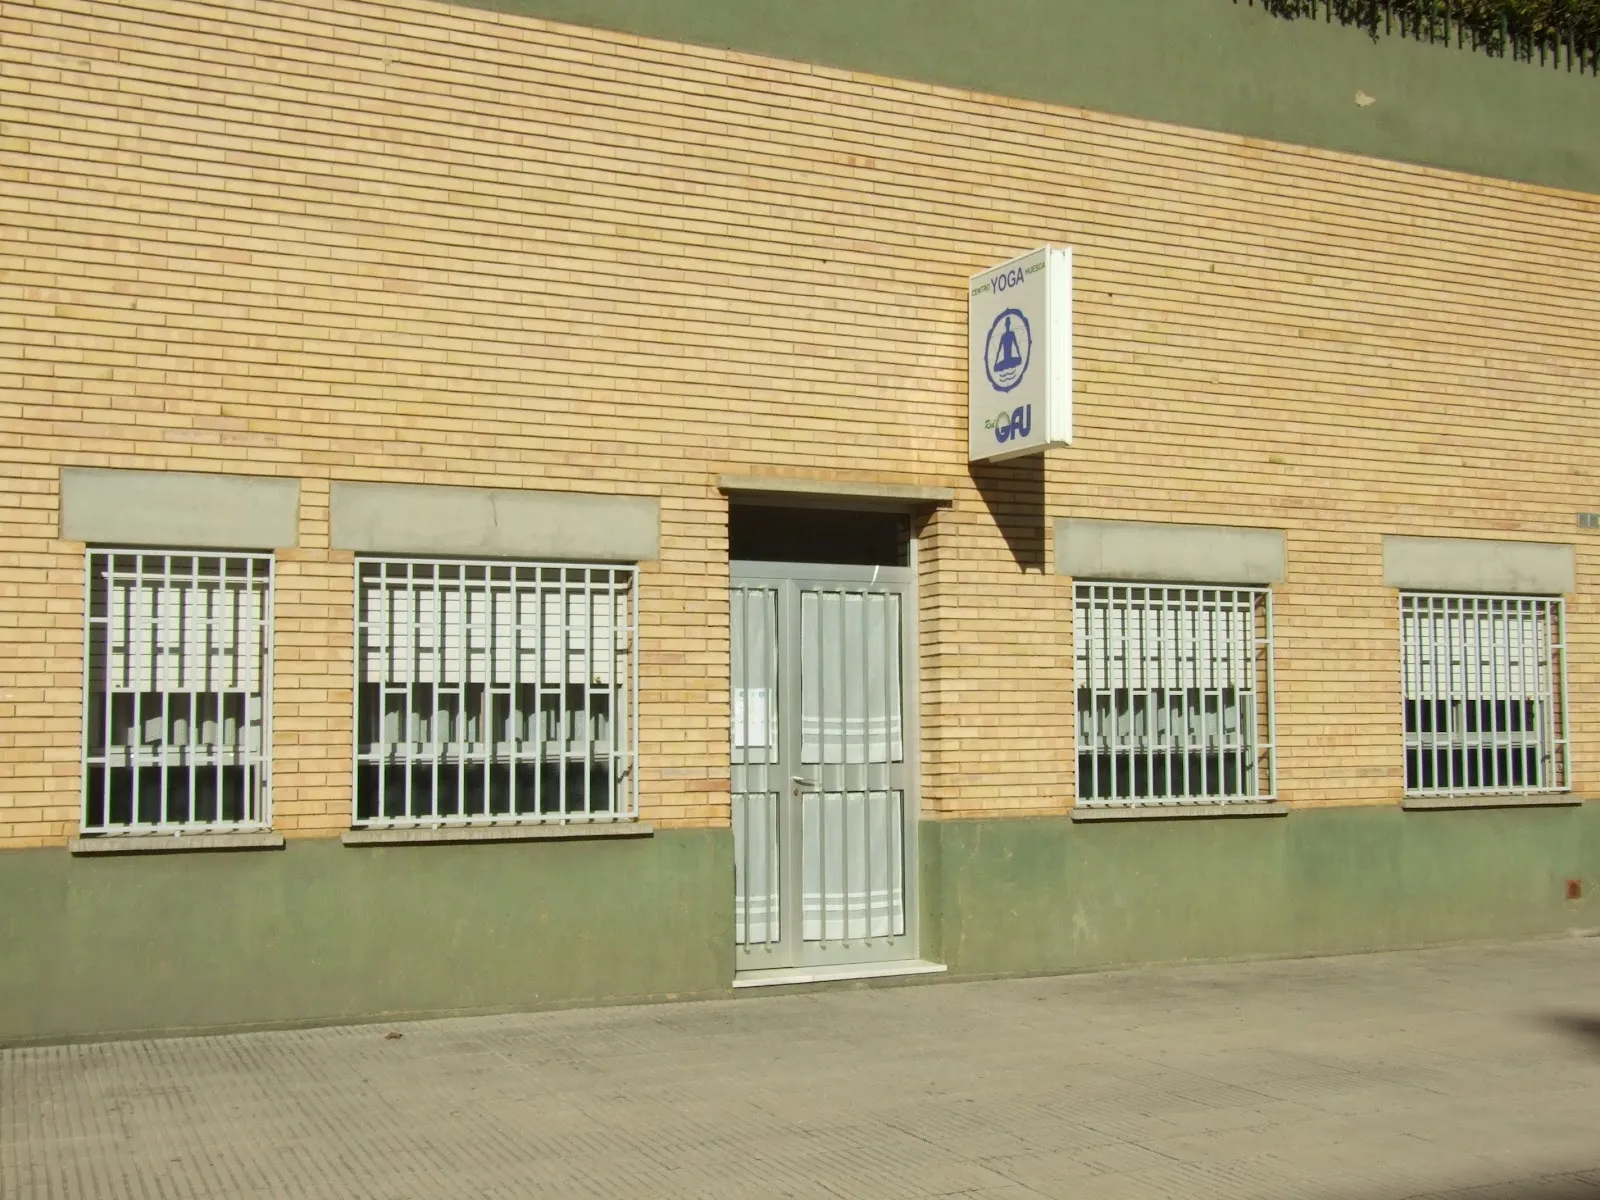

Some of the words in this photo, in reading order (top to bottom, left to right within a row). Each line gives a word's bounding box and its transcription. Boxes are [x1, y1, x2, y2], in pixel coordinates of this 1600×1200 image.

[971, 284, 990, 296] CENTRO
[990, 267, 1024, 294] YOGA
[1024, 262, 1045, 275] HUESCA
